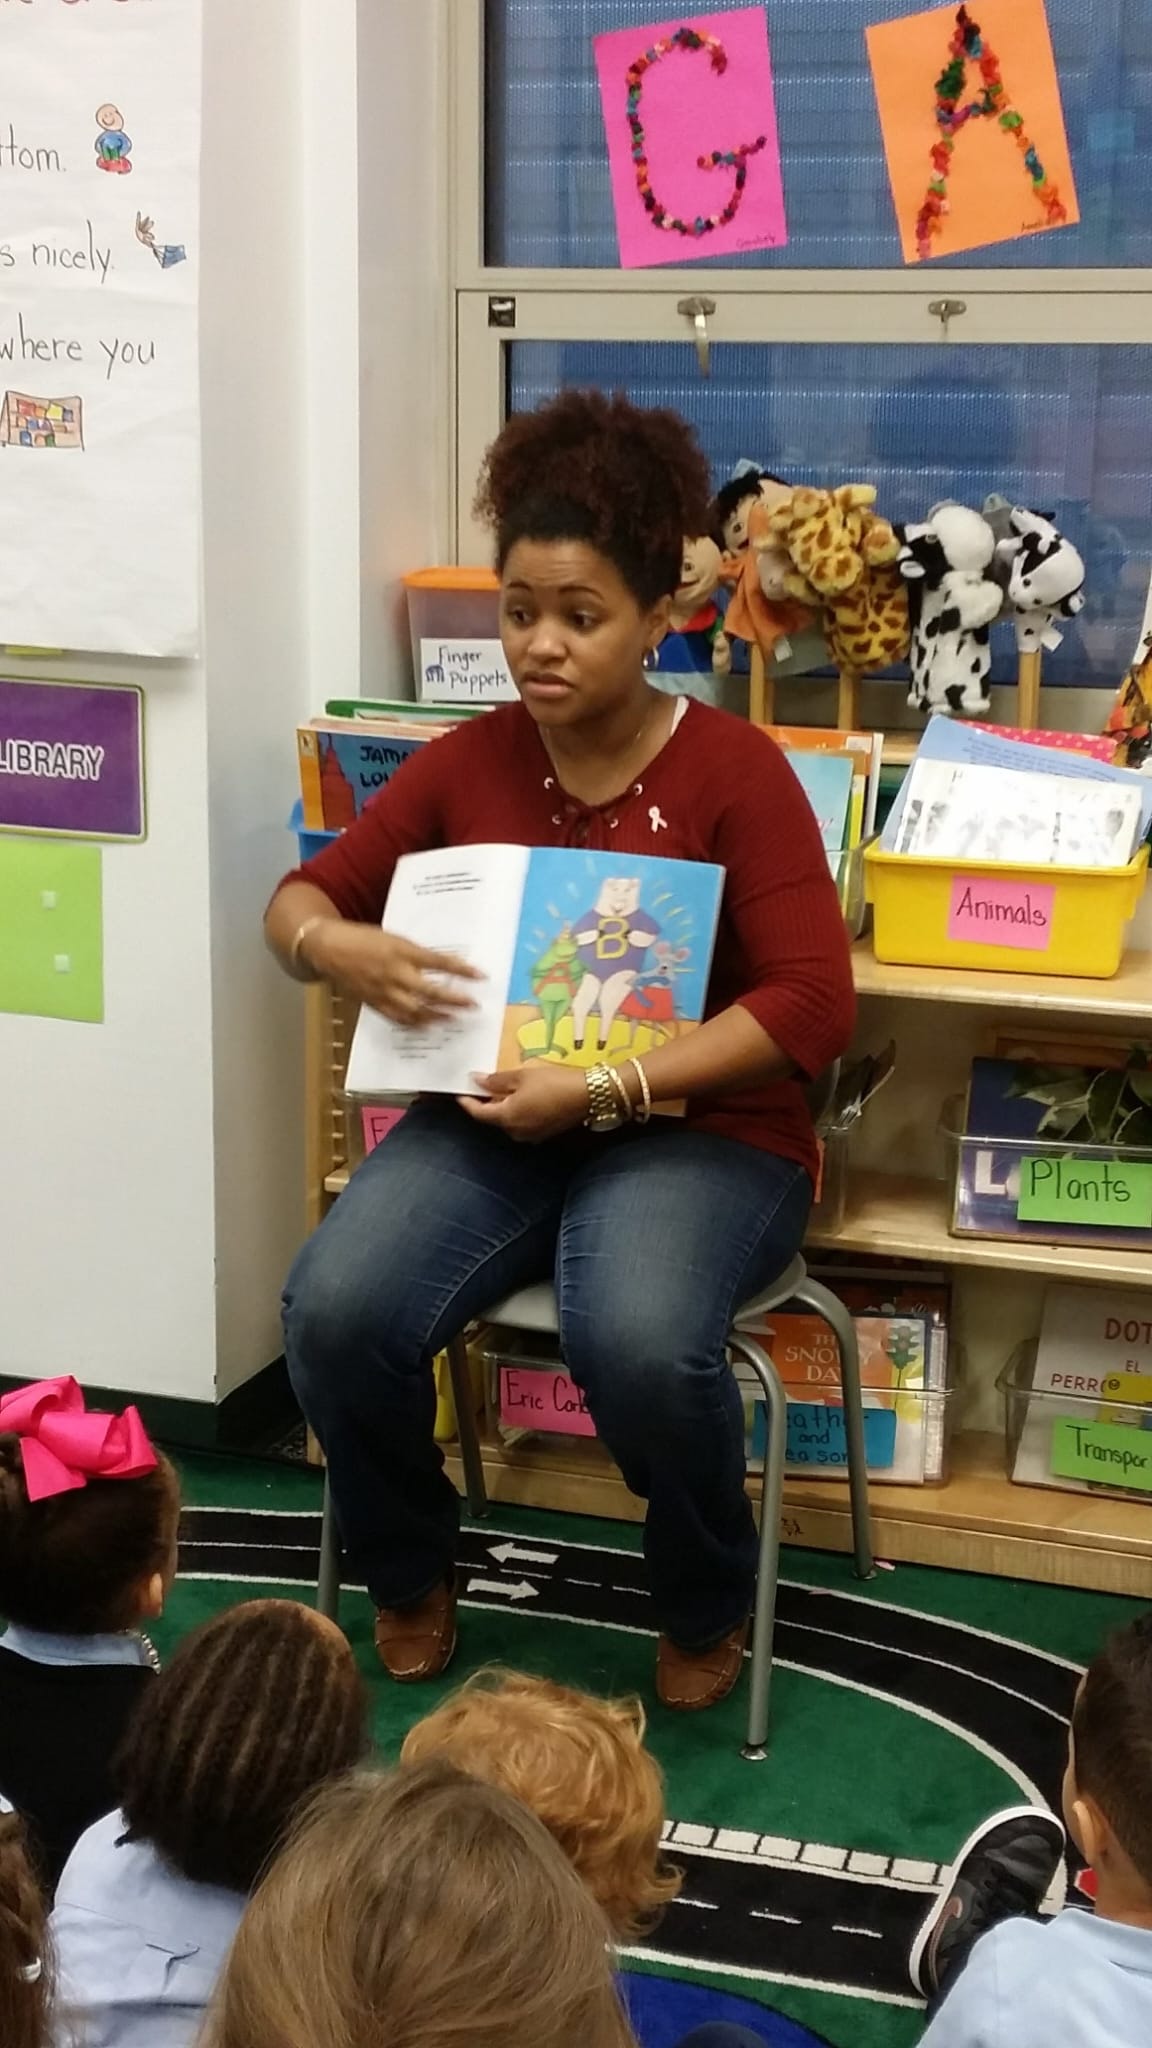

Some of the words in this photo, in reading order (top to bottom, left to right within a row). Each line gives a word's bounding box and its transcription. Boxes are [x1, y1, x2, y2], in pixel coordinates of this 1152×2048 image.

[627, 26, 768, 239] G
[916, 3, 1068, 258] A
[32, 218, 115, 285] nicely.
[0, 311, 83, 362] where
[99, 337, 155, 380] you
[438, 645, 482, 671] Finger
[0, 738, 104, 781] LIBRARY
[956, 886, 1047, 926] Animals
[595, 915, 630, 960] B
[1031, 1158, 1131, 1203] Plants
[785, 1346, 873, 1366] SNOY
[811, 1333, 837, 1346] TH
[806, 1364, 841, 1383] DA
[1125, 1359, 1141, 1374] EL
[506, 1370, 544, 1410] Eric
[798, 1430, 830, 1445] and
